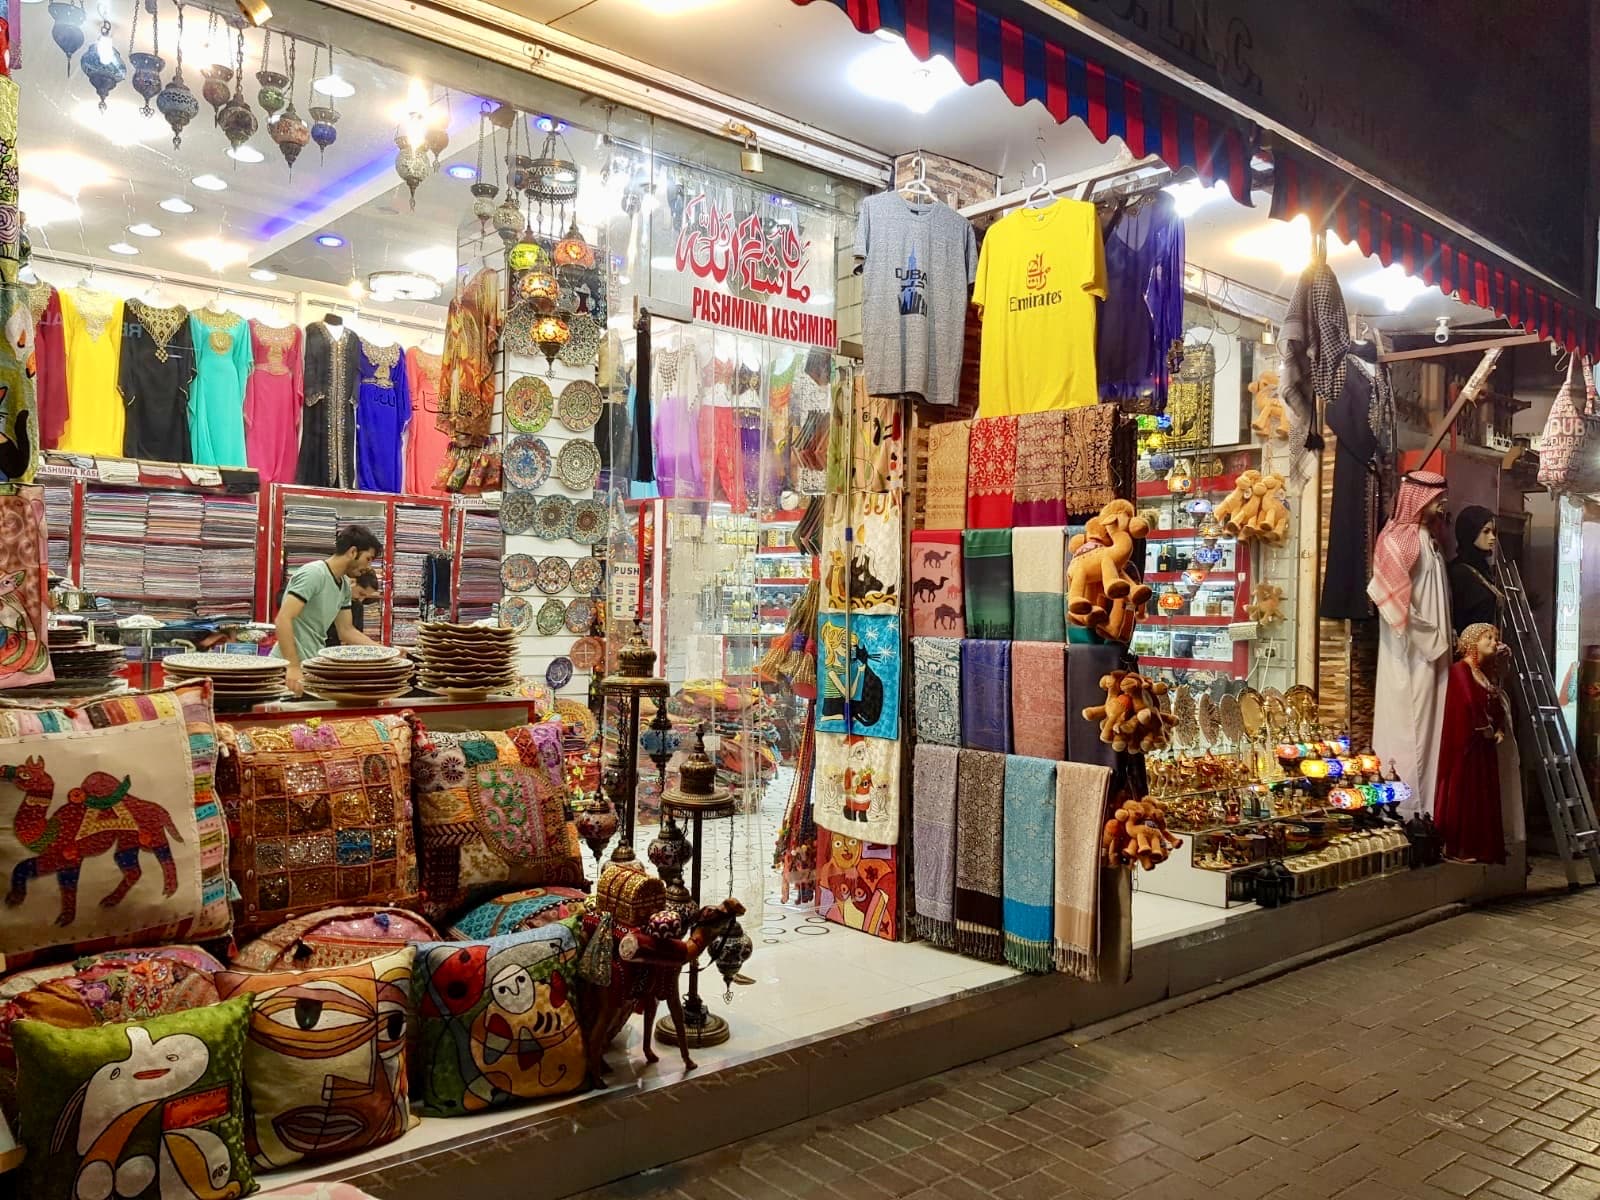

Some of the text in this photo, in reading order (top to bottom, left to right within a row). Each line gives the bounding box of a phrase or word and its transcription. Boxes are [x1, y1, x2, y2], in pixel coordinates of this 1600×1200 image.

[895, 267, 928, 284] DUBA
[1009, 290, 1062, 312] Emirates
[693, 287, 838, 348] PASHMINA KASHMIRI
[614, 566, 640, 576] PUSH
